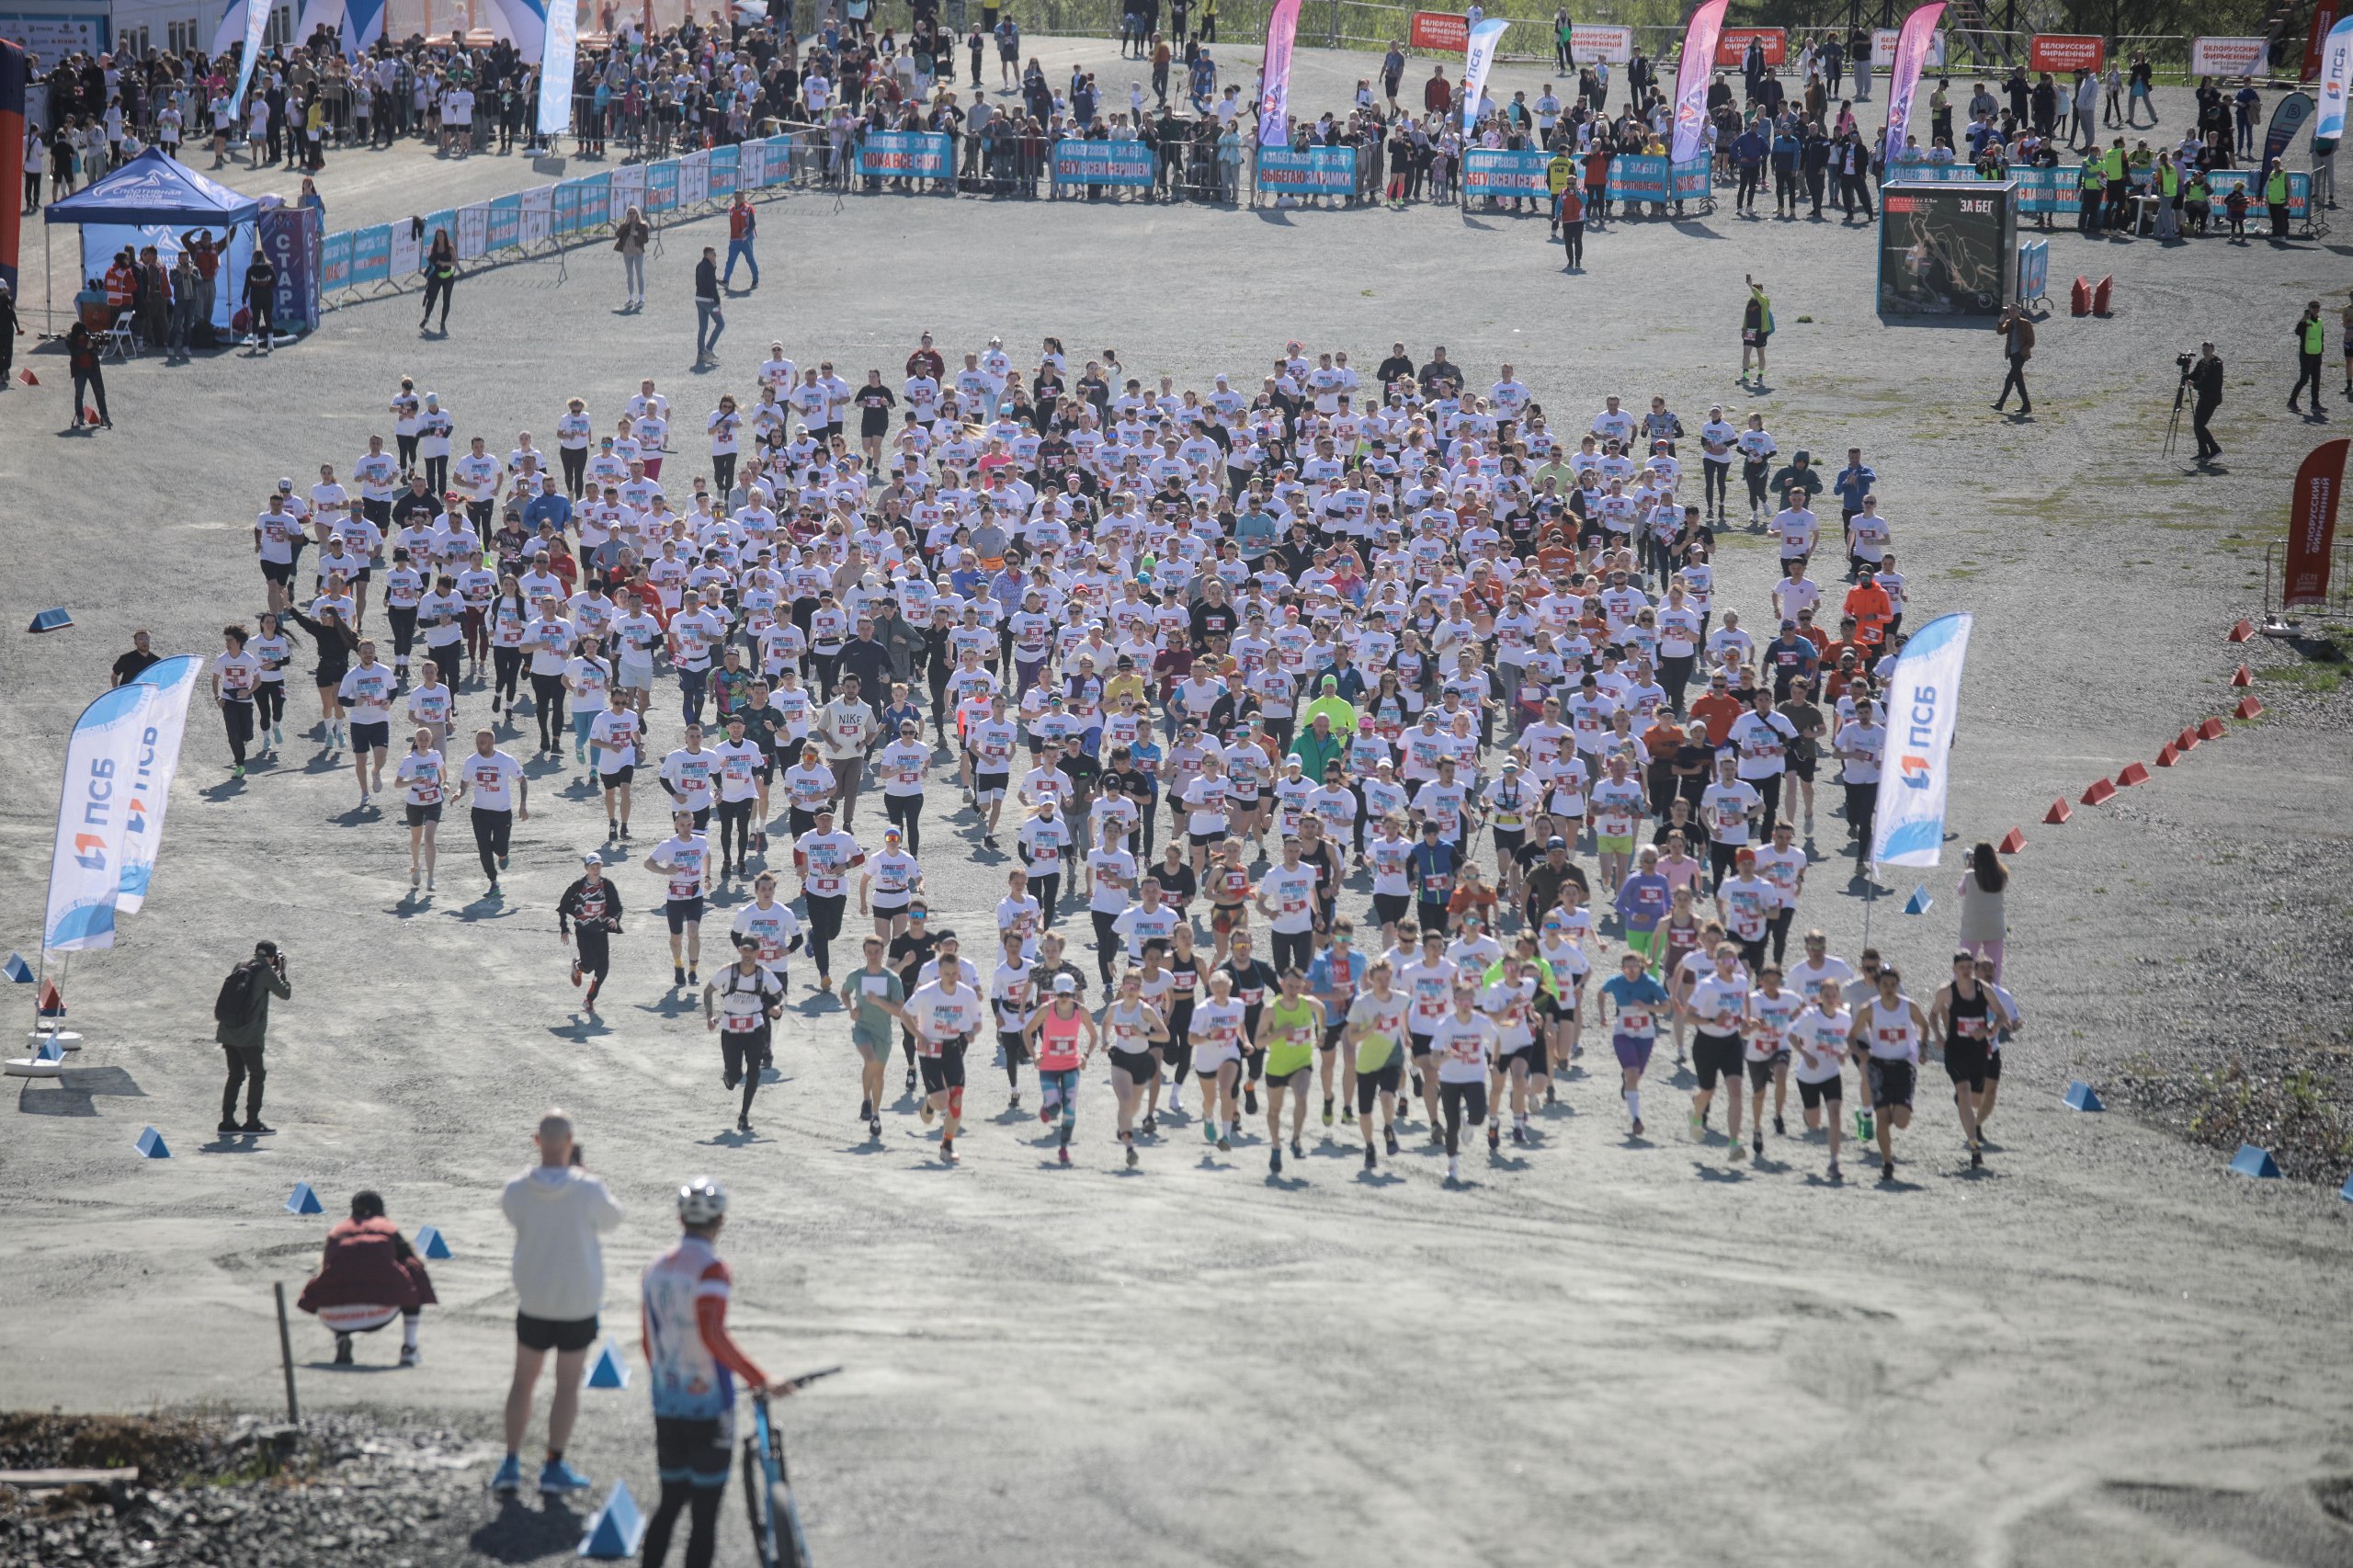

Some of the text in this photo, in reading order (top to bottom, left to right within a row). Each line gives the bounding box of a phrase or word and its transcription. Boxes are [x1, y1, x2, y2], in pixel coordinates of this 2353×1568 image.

[1421, 19, 1467, 30] БЕЛОРУССКИ
[1571, 31, 1622, 40] БЕЛОРУССКИЙ
[1571, 40, 1622, 49] ФИРМЕННЫЙ
[2040, 42, 2095, 51] БЕЛОРУССКИЙ
[2203, 45, 2260, 53] БЕЛОРУССКИЙ
[2040, 50, 2095, 58] ФИРМЕННЫЙ
[2203, 52, 2259, 61] ФИРМЕННЫЙ
[1467, 48, 1483, 78] ПСБ
[2331, 47, 2346, 79] ПСБ
[863, 153, 941, 170] ПОКА ВСЕ СПЯТ
[1059, 160, 1151, 177] БЕГУ ВСЕМ СЕРДЦЕМ
[1261, 168, 1305, 184] ВЫБЕГАЮ
[1320, 171, 1351, 187] РАМКИ
[1466, 172, 1488, 187] БЕГУ
[1490, 173, 1515, 187] ВСЕМ
[1975, 199, 1994, 213] БЕГ
[276, 233, 293, 320] СТАРТ
[305, 231, 316, 324] СТАРТ
[838, 713, 862, 725] NIKE
[1909, 686, 1937, 748] ПСБ
[85, 757, 116, 825] ПСБ
